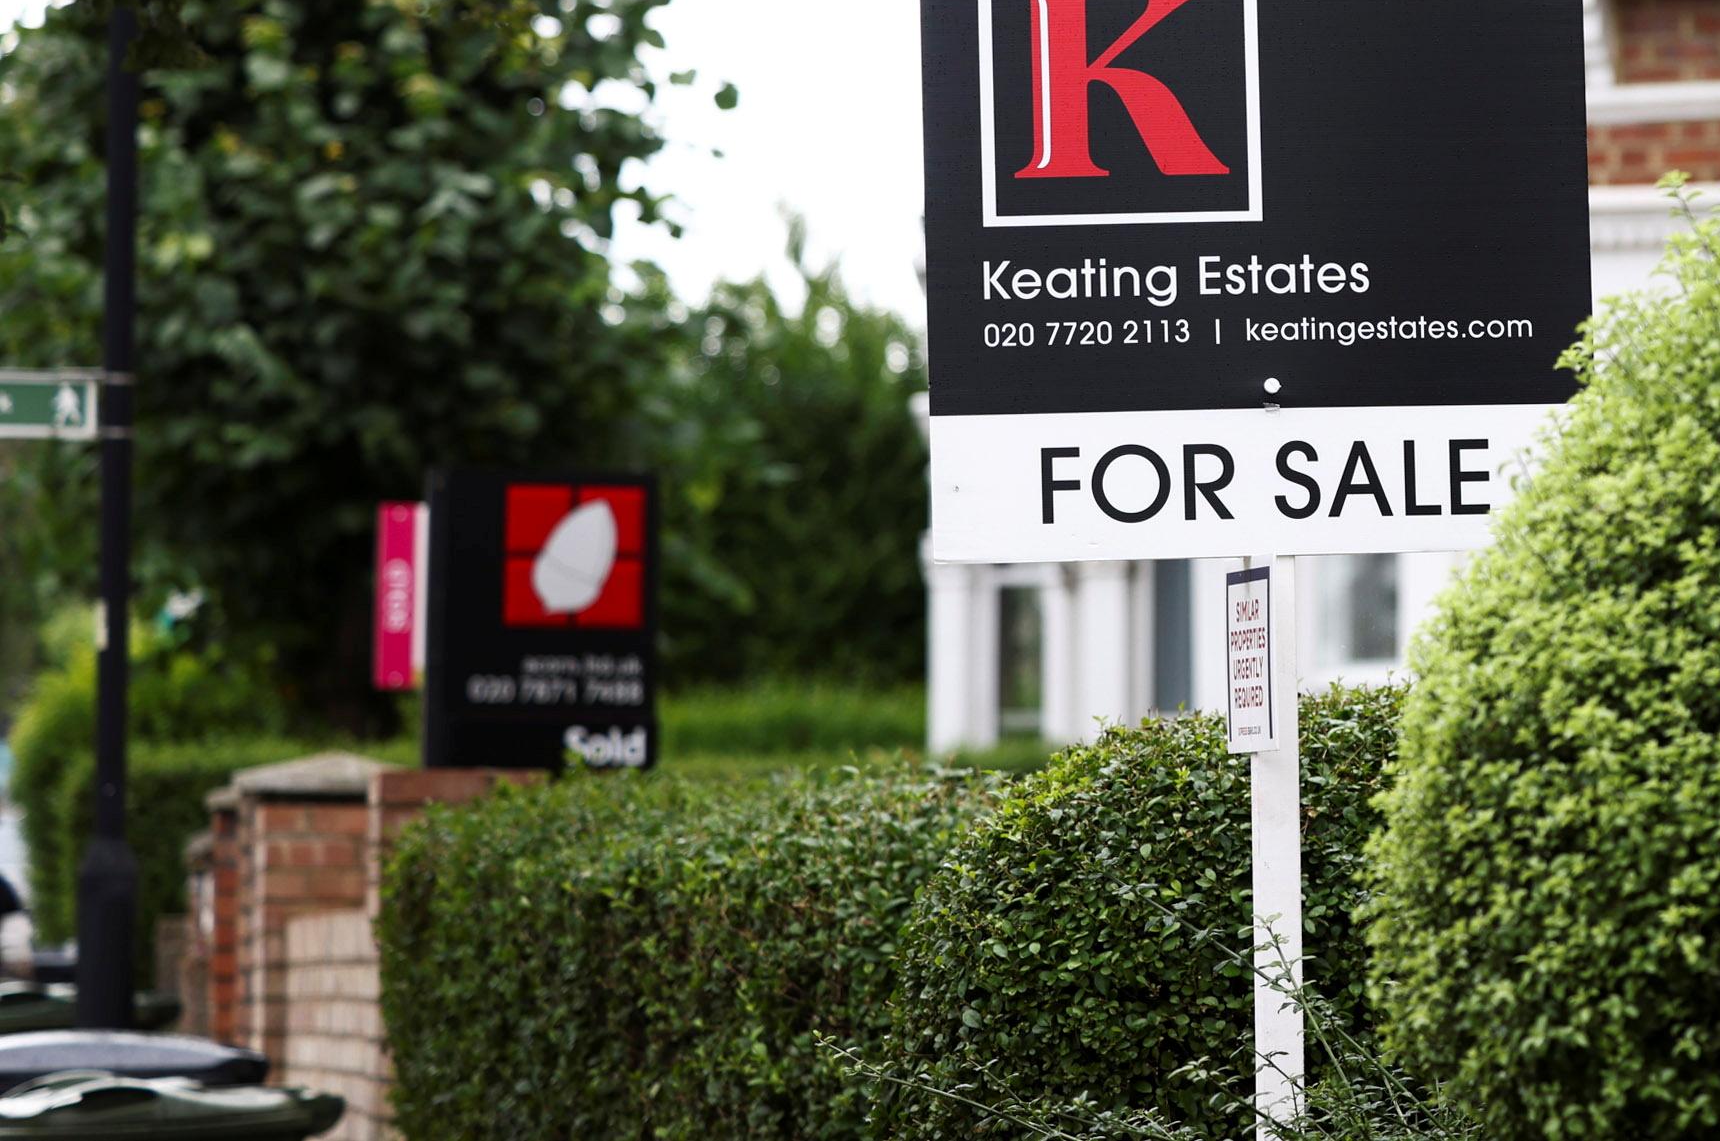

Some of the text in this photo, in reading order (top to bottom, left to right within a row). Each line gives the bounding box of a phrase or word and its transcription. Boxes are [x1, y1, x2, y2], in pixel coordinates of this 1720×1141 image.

[982, 253, 1371, 307] Keating Estates
[983, 314, 1534, 347] 020 7720 2113 keatingestates.com
[1040, 437, 1492, 525] FOR SALE
[1236, 599, 1260, 622] SIMILAR
[1231, 627, 1266, 652] PROPERTIES
[1233, 656, 1264, 680] URGENTLY
[1234, 685, 1264, 709] REQUIRED
[563, 725, 648, 767] Sold
